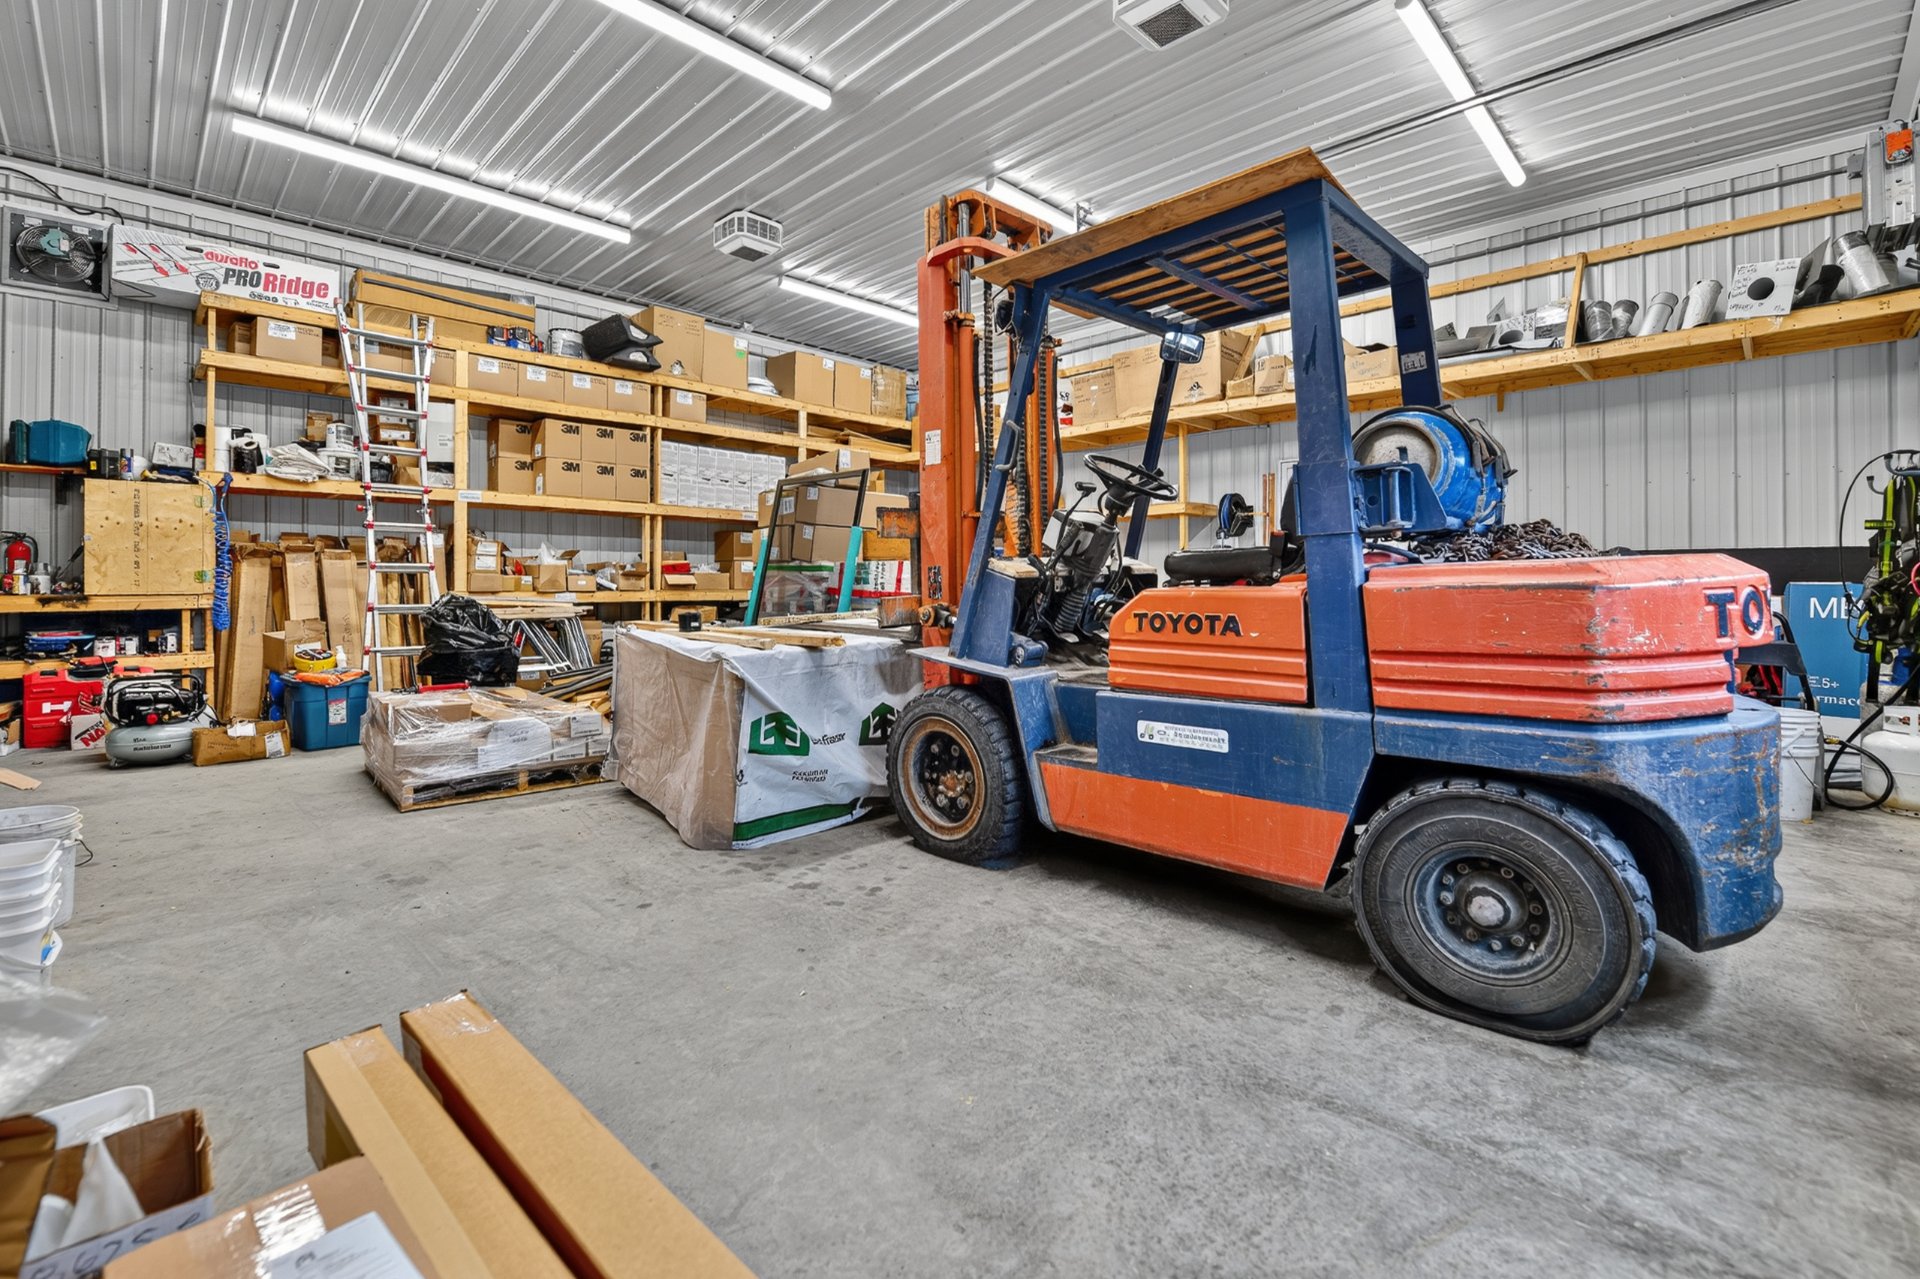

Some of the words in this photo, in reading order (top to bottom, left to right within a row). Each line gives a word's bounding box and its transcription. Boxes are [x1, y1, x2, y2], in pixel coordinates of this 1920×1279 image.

[222, 267, 262, 288] PRO
[262, 272, 329, 300] Ridge
[515, 423, 533, 435] 3M
[561, 423, 580, 436] 3M
[596, 427, 614, 440] 3M
[629, 431, 647, 443] 3M
[514, 460, 534, 472] 3M
[561, 461, 581, 473] 3M
[596, 465, 615, 476] 3M
[630, 468, 648, 479] 3M
[1132, 611, 1243, 637] TOYOTA
